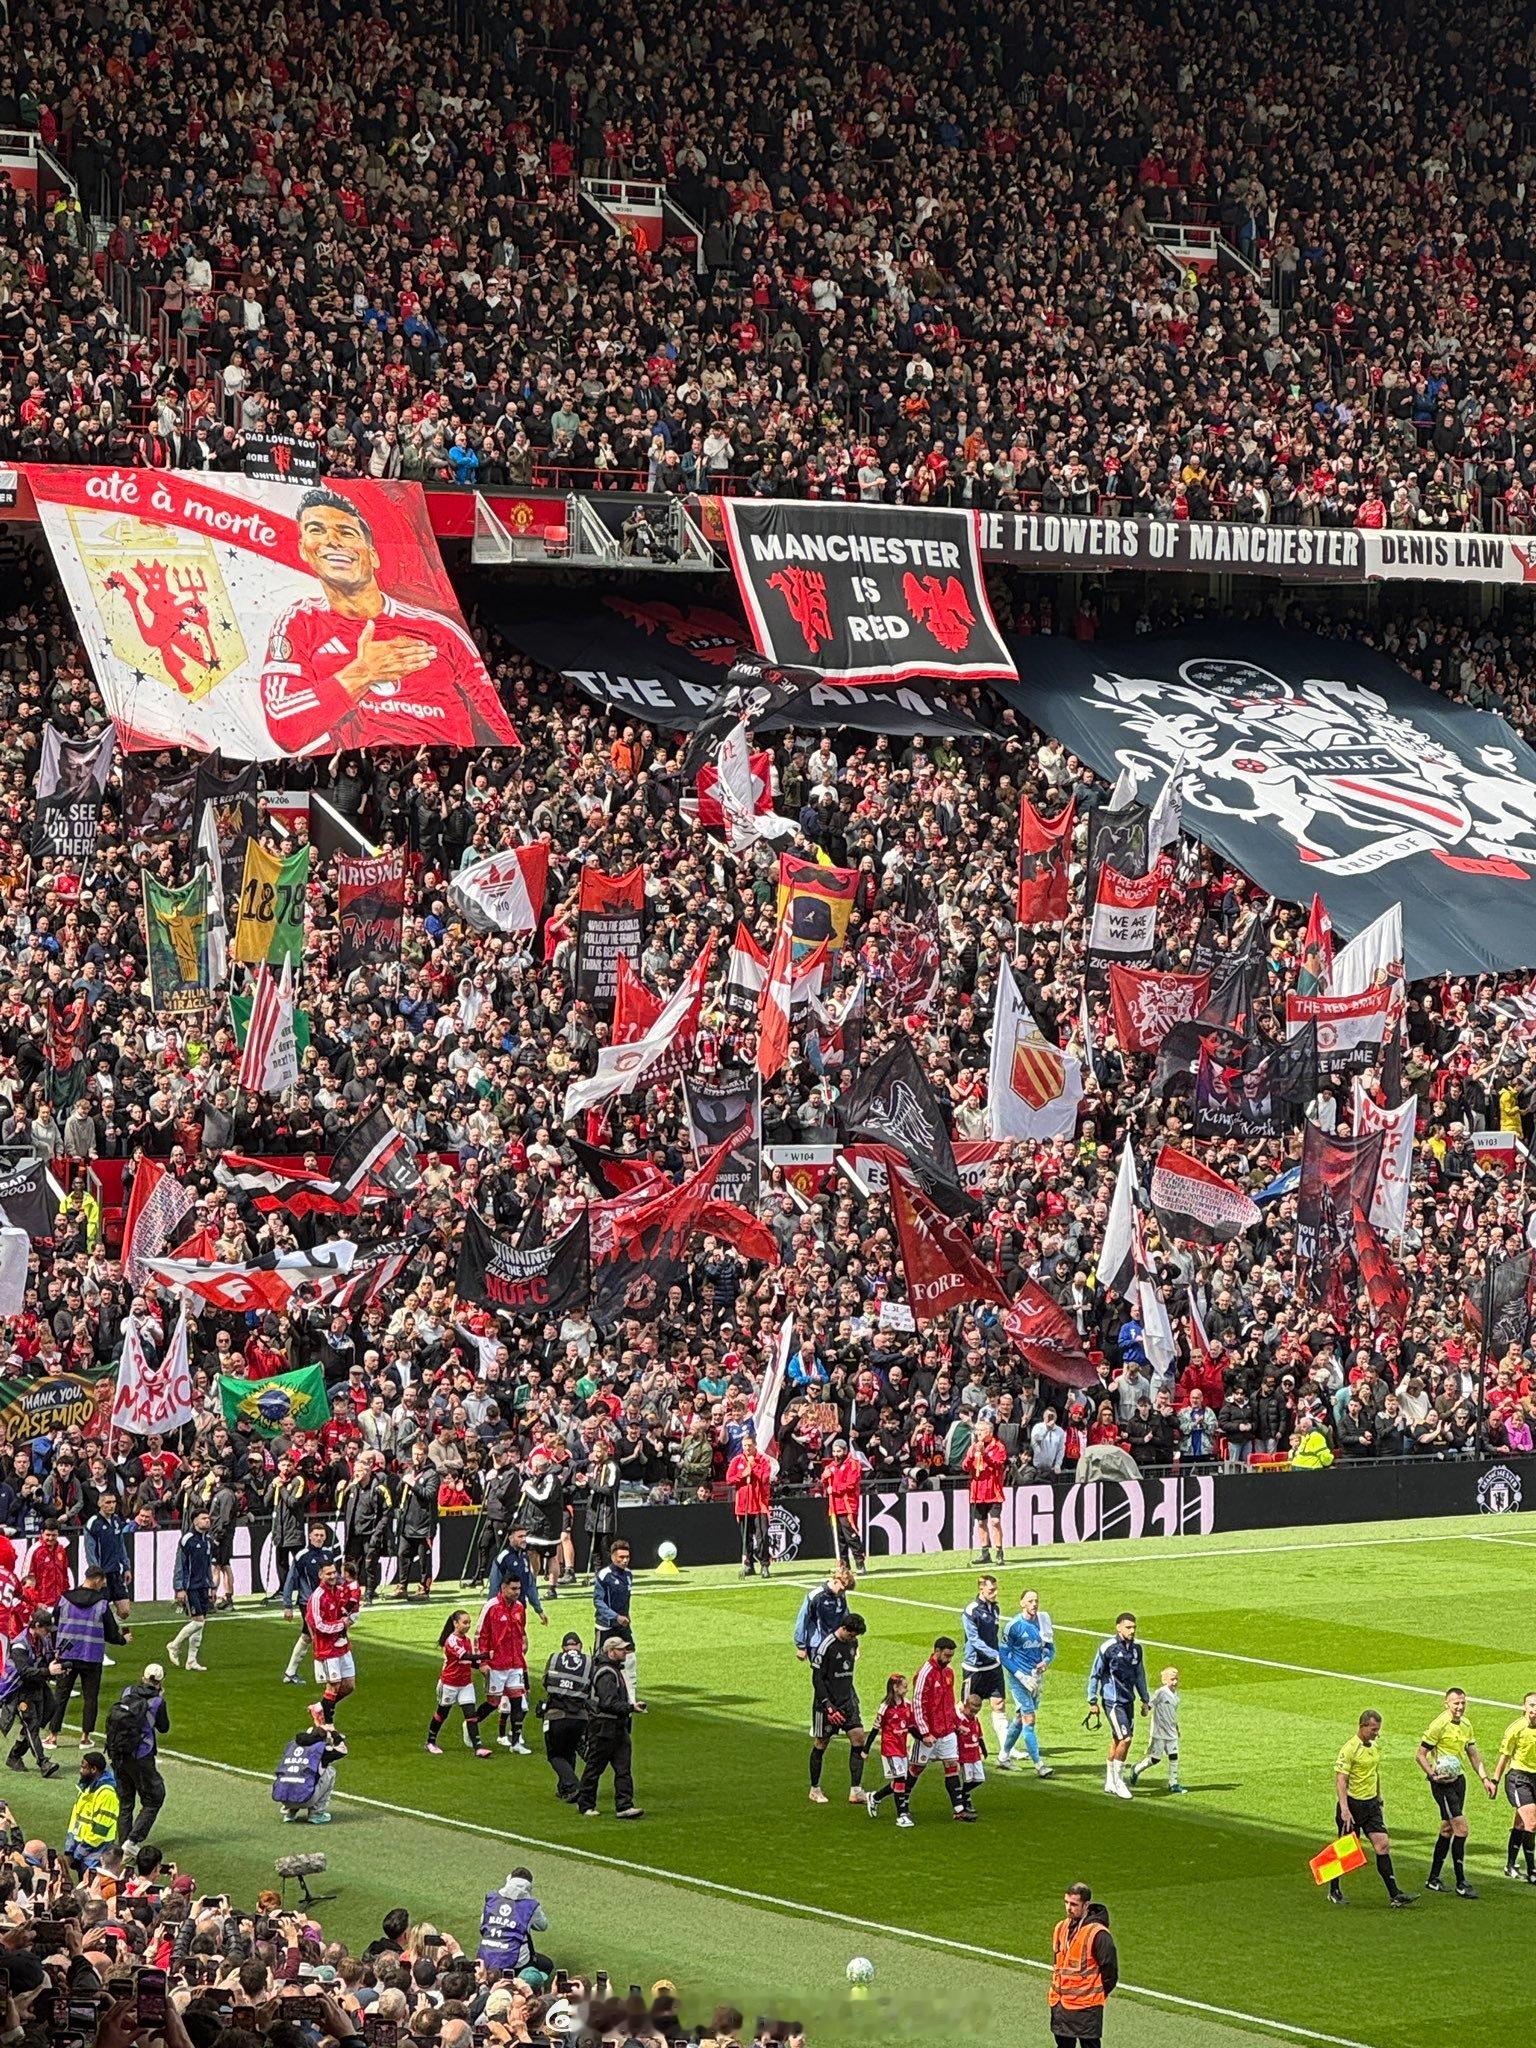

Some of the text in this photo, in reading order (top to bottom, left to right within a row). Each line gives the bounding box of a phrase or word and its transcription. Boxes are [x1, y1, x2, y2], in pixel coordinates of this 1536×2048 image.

[245, 432, 316, 449] DAD LOVES YOU
[85, 471, 278, 548] até à morte
[750, 533, 961, 570] MANCHESTER
[979, 514, 1359, 567] HE FLOWERS OF MANCHESTER
[1381, 534, 1505, 569] DENIS LAW
[852, 576, 881, 604] IS
[850, 615, 910, 643] RED
[562, 670, 676, 708] THE
[69, 804, 96, 821] SEE
[1338, 849, 1390, 871] PRIDE
[1395, 837, 1421, 851] OF
[338, 860, 403, 887] ARISING
[242, 878, 305, 926] 1878
[1109, 915, 1147, 927] WE ARE
[1109, 928, 1147, 940] WE ARE
[1295, 1000, 1320, 1014] THE
[1322, 1003, 1349, 1014] RED
[731, 1125, 752, 1147] UNITED
[1478, 1138, 1498, 1147] W103
[790, 1152, 815, 1162] W104
[0, 1181, 37, 1198] GOOD
[741, 1172, 751, 1182] OF
[709, 1183, 744, 1202] CILY
[484, 1273, 550, 1306] MUFC
[912, 1273, 965, 1301] FORE
[20, 1388, 57, 1411] THANK
[6, 1400, 94, 1442] CASEMIRO
[560, 1679, 574, 1690] 201
